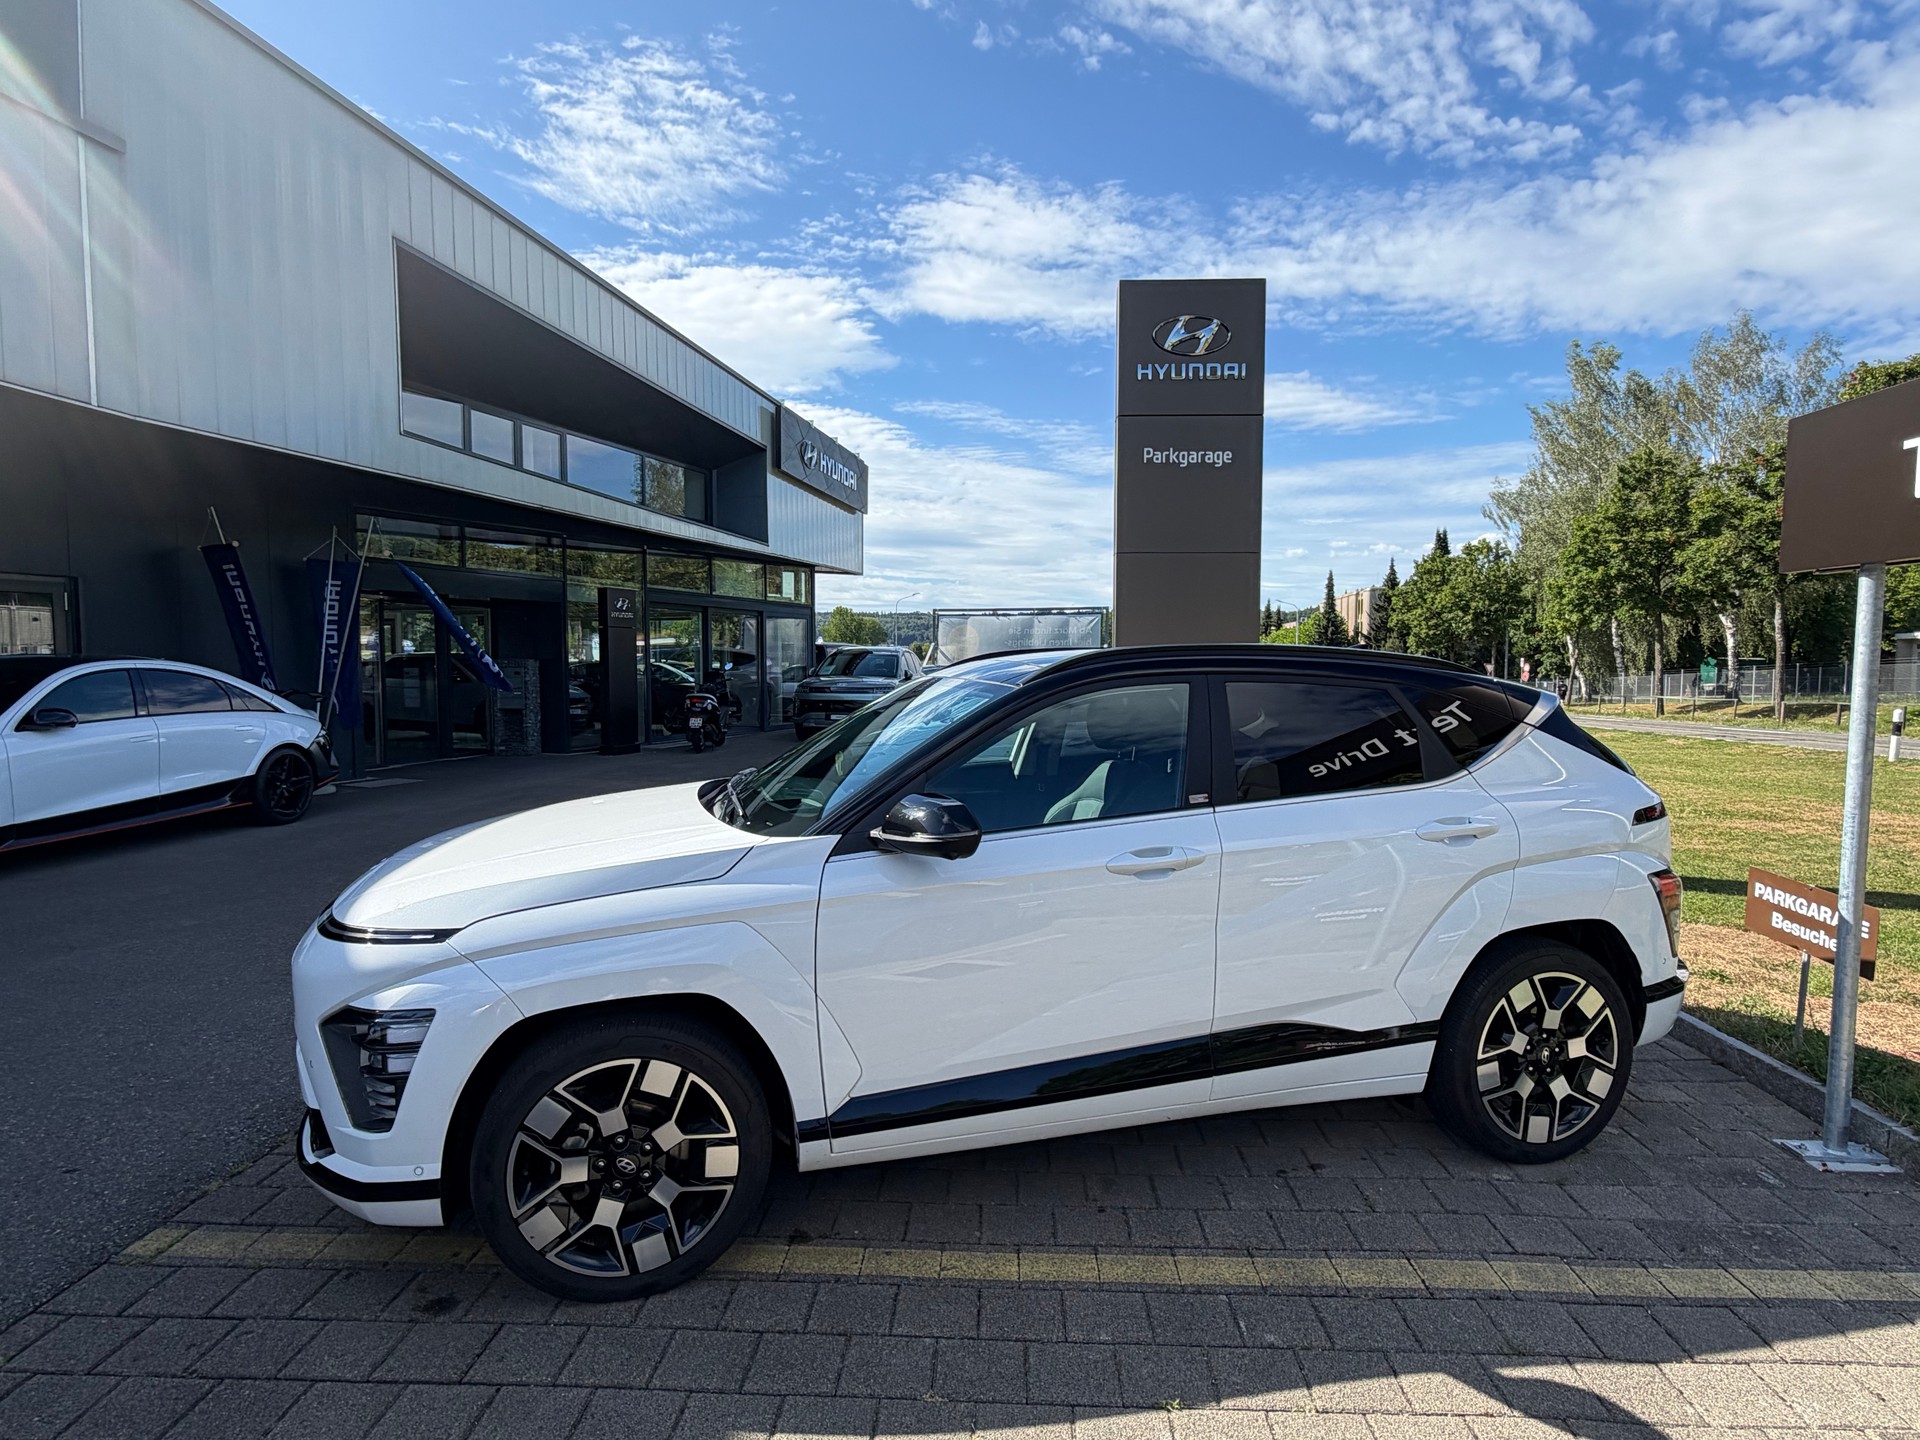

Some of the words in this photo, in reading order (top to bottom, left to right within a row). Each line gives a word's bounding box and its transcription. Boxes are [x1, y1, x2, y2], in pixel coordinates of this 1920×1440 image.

[1136, 363, 1247, 380] HYUNDAI
[820, 452, 857, 491] HYUNDAI
[1143, 447, 1233, 467] Parkgarage
[222, 563, 267, 667] HYUNDAI
[322, 579, 342, 668] YUNDAI
[1754, 882, 1871, 939] PARKGARAE
[1771, 911, 1838, 952] Besuche
